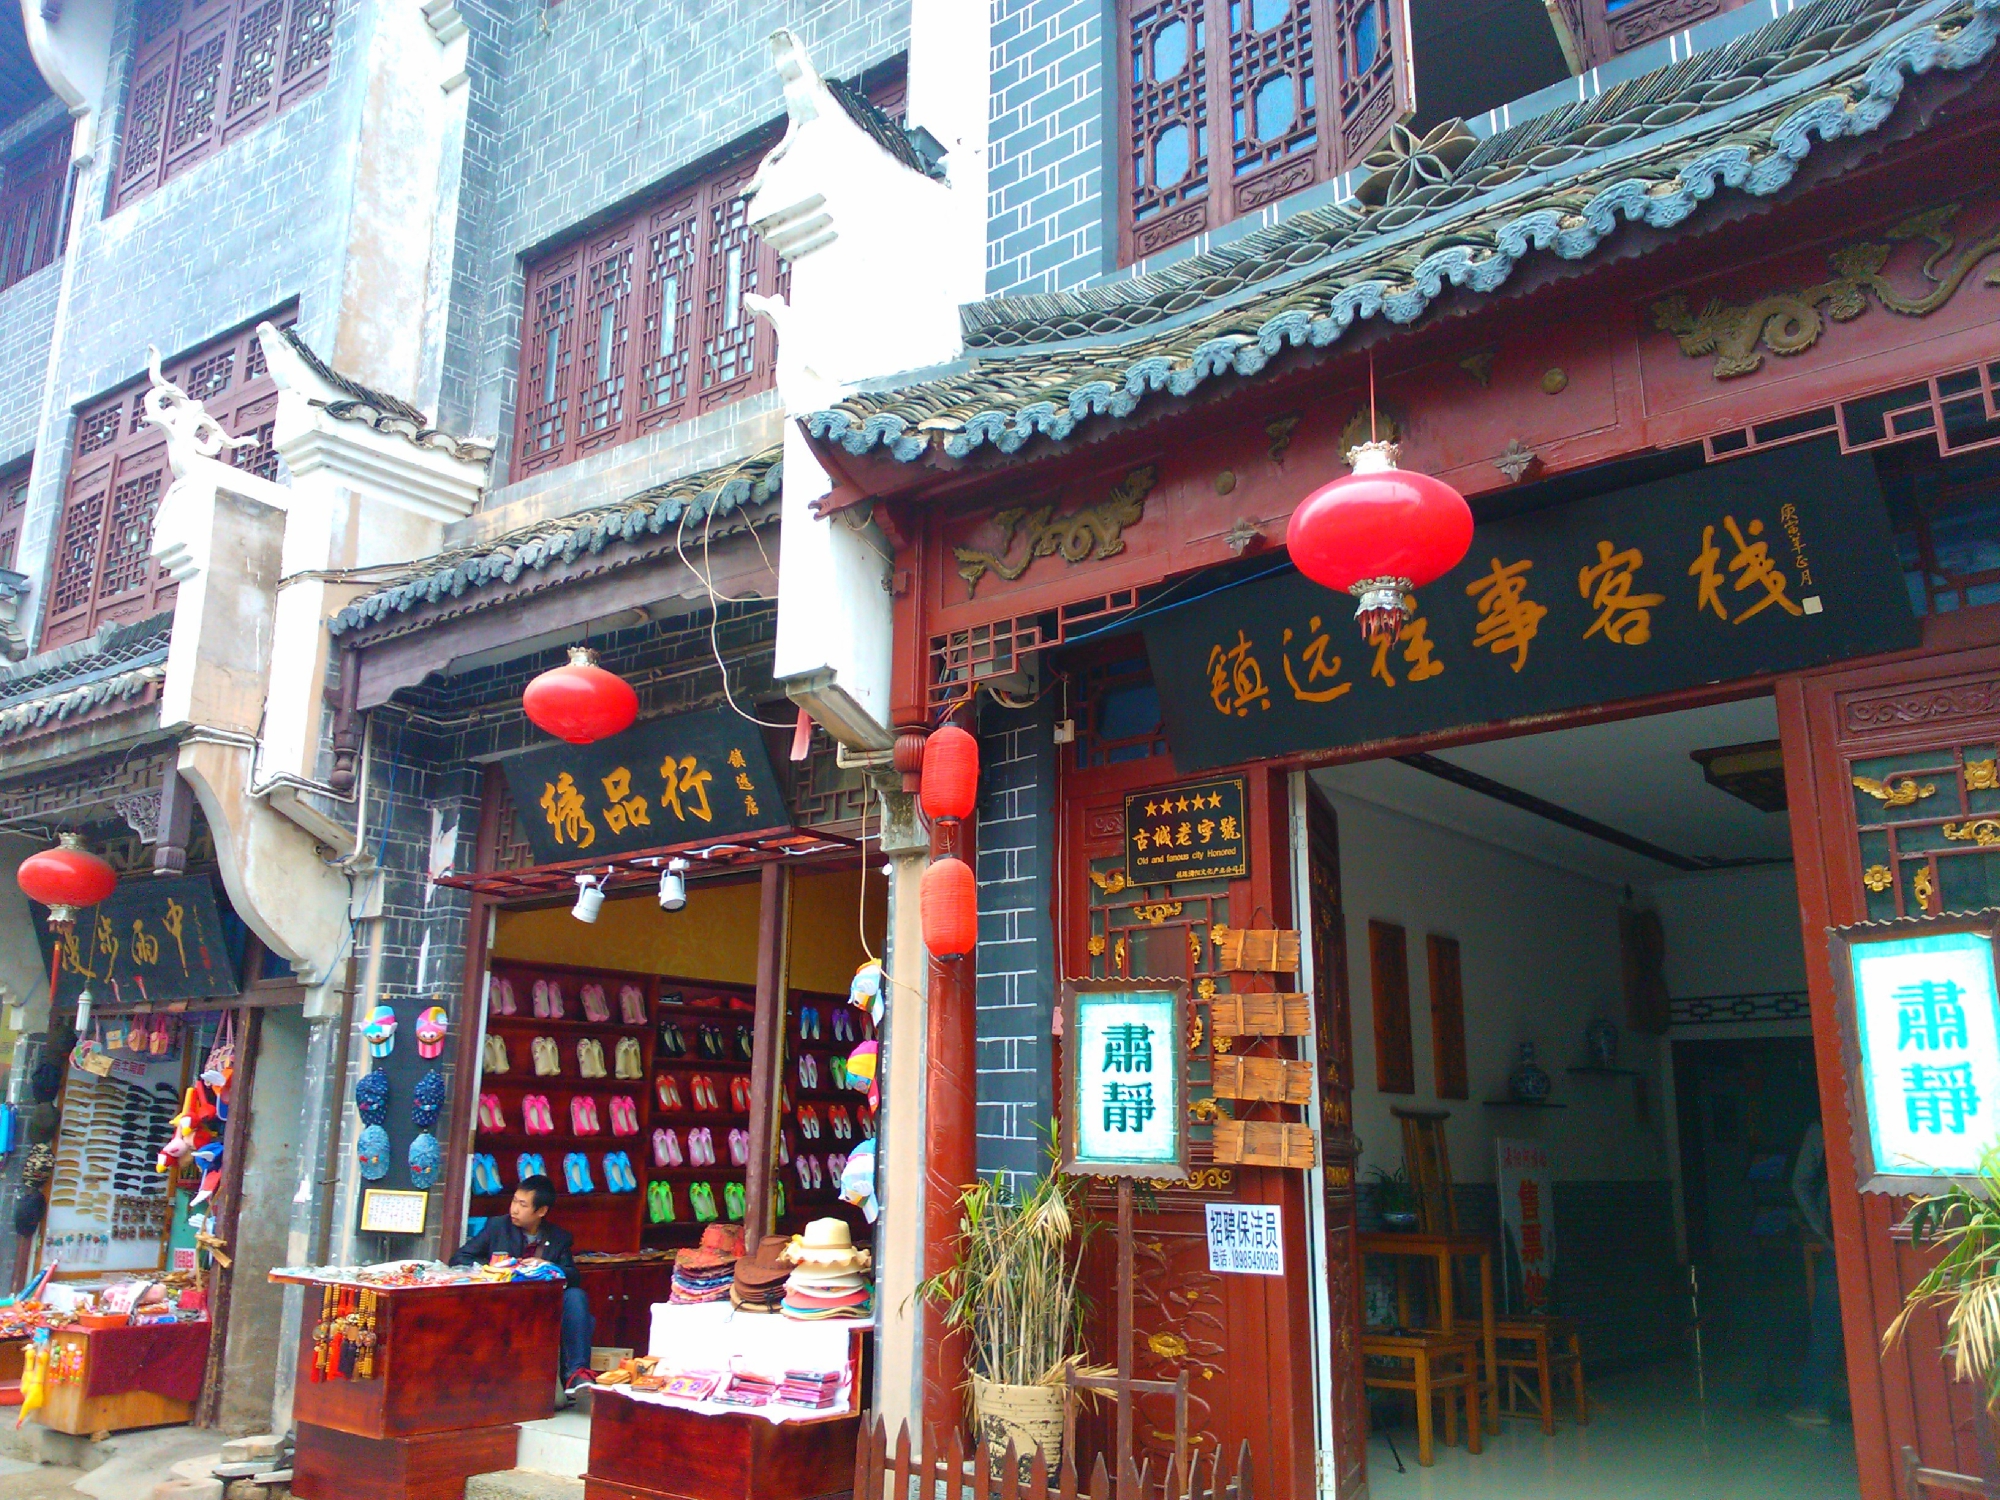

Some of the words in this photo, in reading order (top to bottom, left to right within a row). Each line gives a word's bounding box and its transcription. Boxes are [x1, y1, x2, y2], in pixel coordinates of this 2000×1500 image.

[1136, 856, 1149, 866] Old
[1151, 855, 1164, 864] and
[1191, 850, 1205, 861] city
[1207, 846, 1237, 858] Honored
[1210, 1208, 1279, 1250] 招聘保洁员
